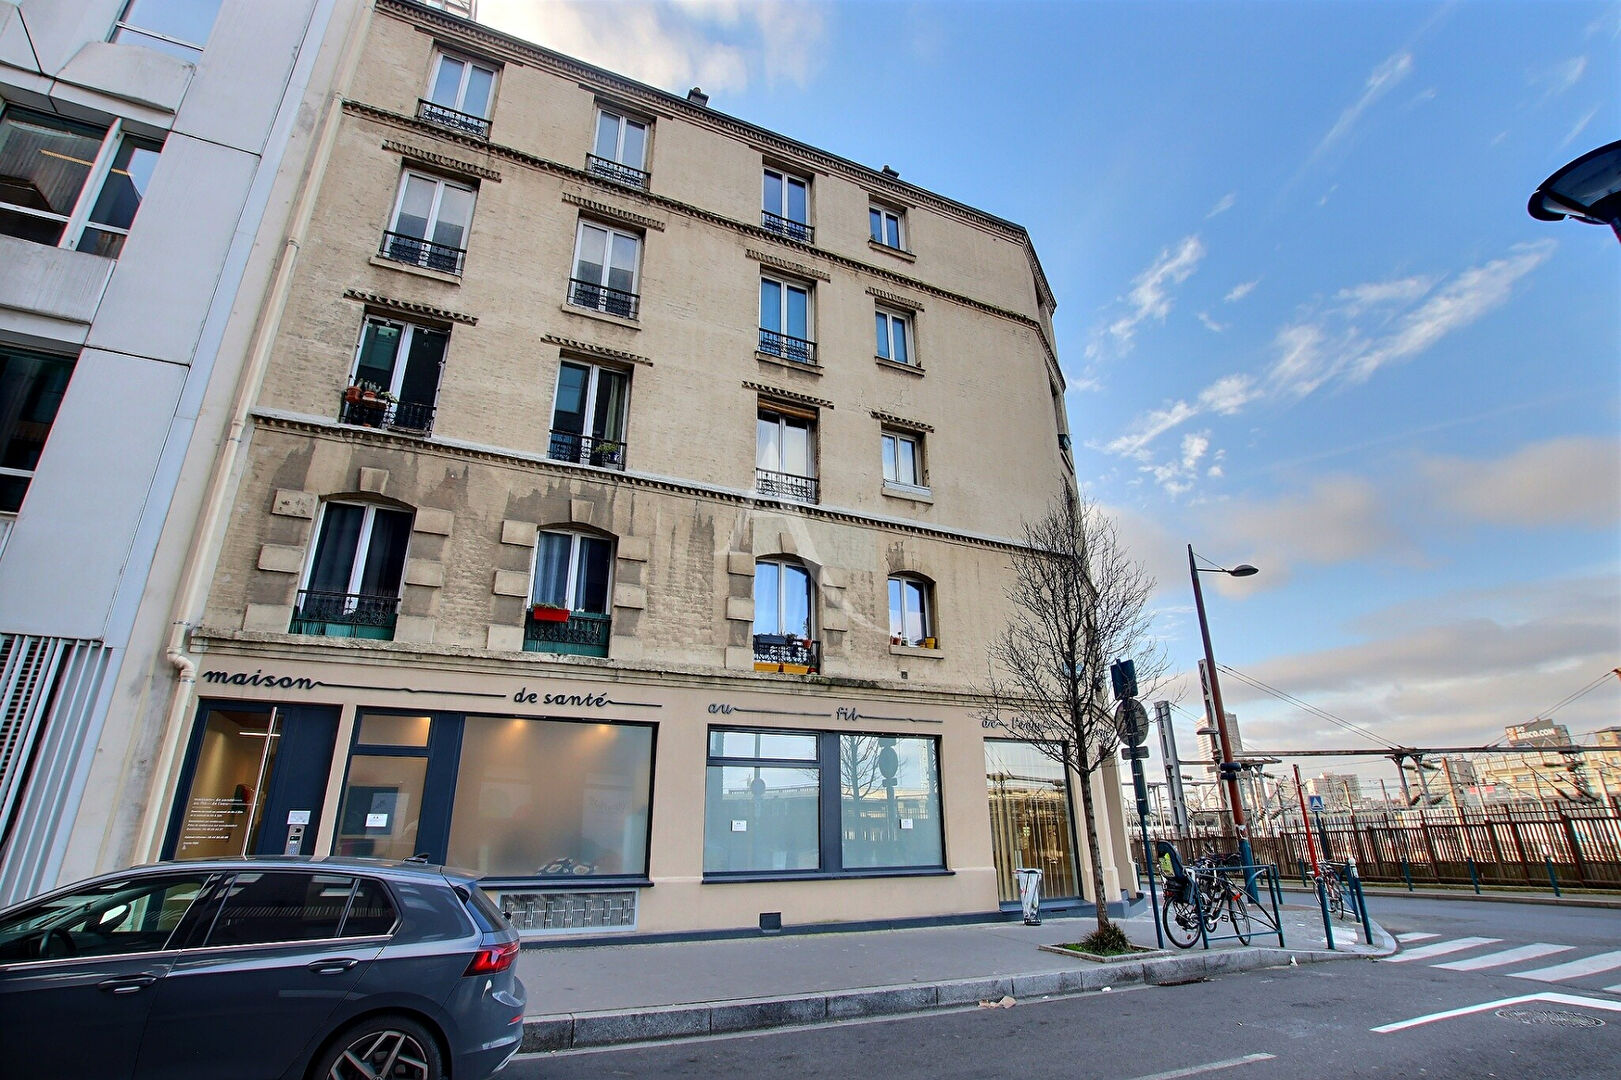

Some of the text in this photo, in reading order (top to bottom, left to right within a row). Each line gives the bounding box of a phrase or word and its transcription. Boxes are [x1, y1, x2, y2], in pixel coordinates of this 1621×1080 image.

[202, 669, 315, 690] maison
[513, 687, 538, 703] de
[543, 692, 608, 707] santé
[708, 703, 734, 715] au
[836, 707, 859, 721] fil
